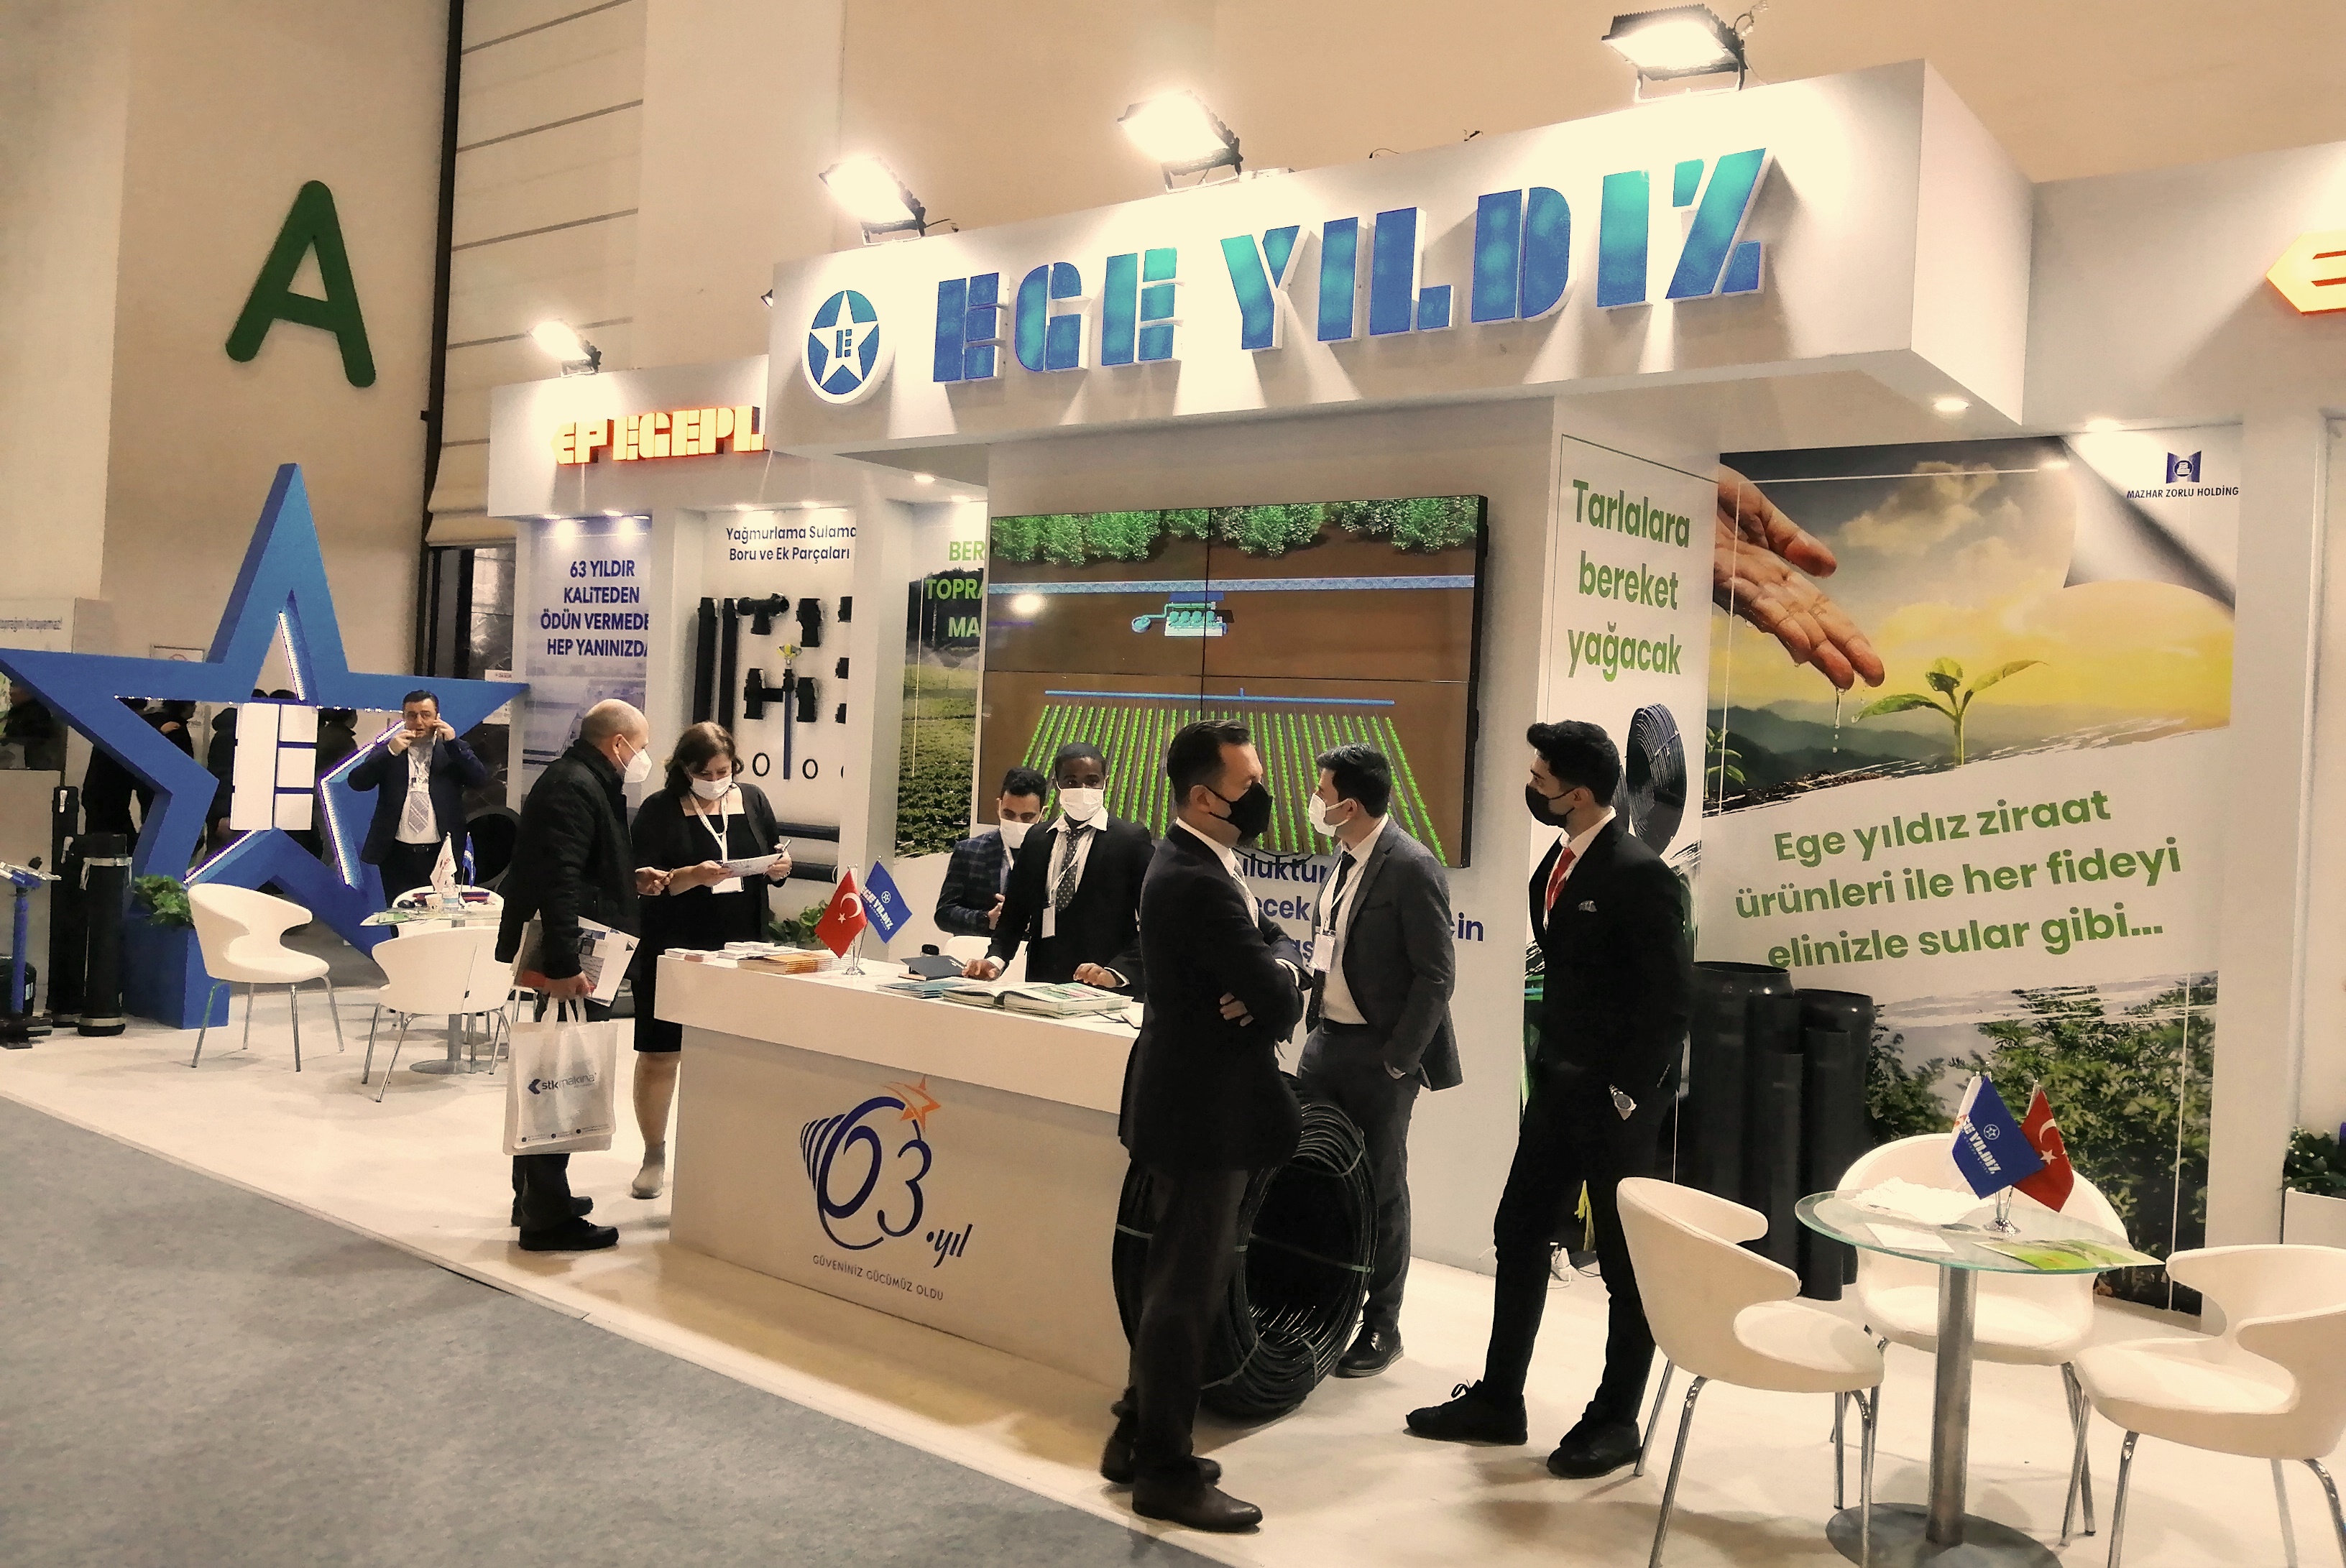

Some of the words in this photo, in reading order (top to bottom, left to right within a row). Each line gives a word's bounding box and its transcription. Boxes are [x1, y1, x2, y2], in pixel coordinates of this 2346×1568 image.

[225, 180, 376, 388] A
[933, 247, 1179, 383] EGE
[1220, 148, 1768, 351] YILDIZ
[1573, 479, 1690, 548] Tarlalara
[2127, 489, 2163, 499] MAZHAR
[2166, 489, 2194, 497] ZORLU
[726, 526, 806, 545] Yağmurlama
[730, 548, 756, 561] Boru
[760, 550, 773, 561] ve
[776, 547, 789, 561] Ek
[792, 546, 850, 564] Parçaları
[949, 540, 985, 561] BER
[570, 561, 586, 578] 63
[589, 560, 635, 577] YILDIR
[1579, 550, 1678, 610] bereket
[540, 608, 581, 630] ÖDÜN
[948, 617, 981, 637] MA
[547, 638, 574, 655] HEP
[1568, 621, 1682, 682] yağacak
[1774, 830, 1845, 867] Ege
[1853, 812, 1970, 862] yıldız
[1977, 790, 2111, 836] ziraat
[1735, 870, 1895, 918] ürünleri
[1903, 867, 1954, 901] ile
[1963, 862, 2037, 895] her
[2047, 836, 2181, 887] fideyi
[1768, 929, 1910, 969] elinizle
[1918, 920, 2030, 956] sular
[2041, 902, 2163, 956] gibi...
[813, 1255, 863, 1278] GÜVENİNİZ
[866, 1270, 913, 1292] GÜCÜMÜZ
[916, 1285, 944, 1301] OLDU
